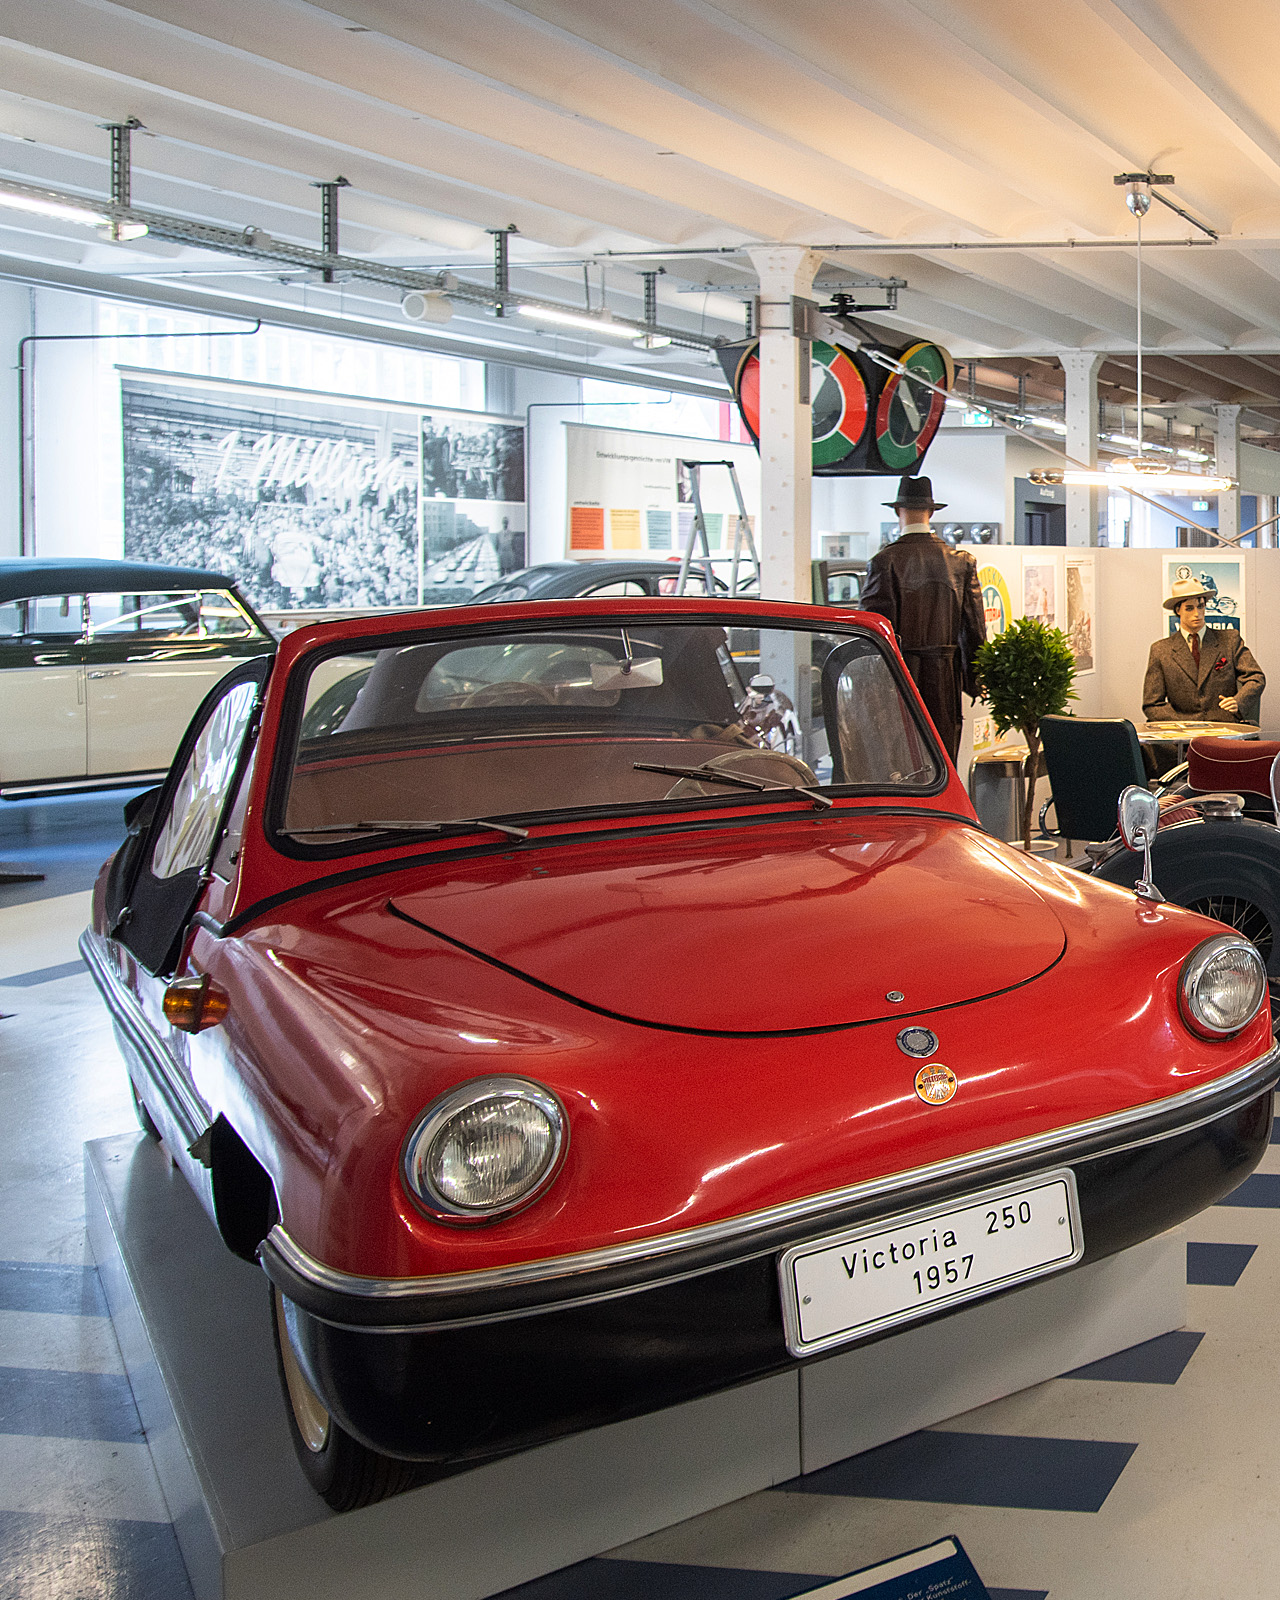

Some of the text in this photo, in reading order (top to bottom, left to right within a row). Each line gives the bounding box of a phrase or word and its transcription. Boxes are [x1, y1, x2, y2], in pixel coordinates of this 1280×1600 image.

[252, 433, 406, 492] Million
[841, 1201, 1032, 1279] Victoria 250
[913, 1254, 974, 1295] 1957
